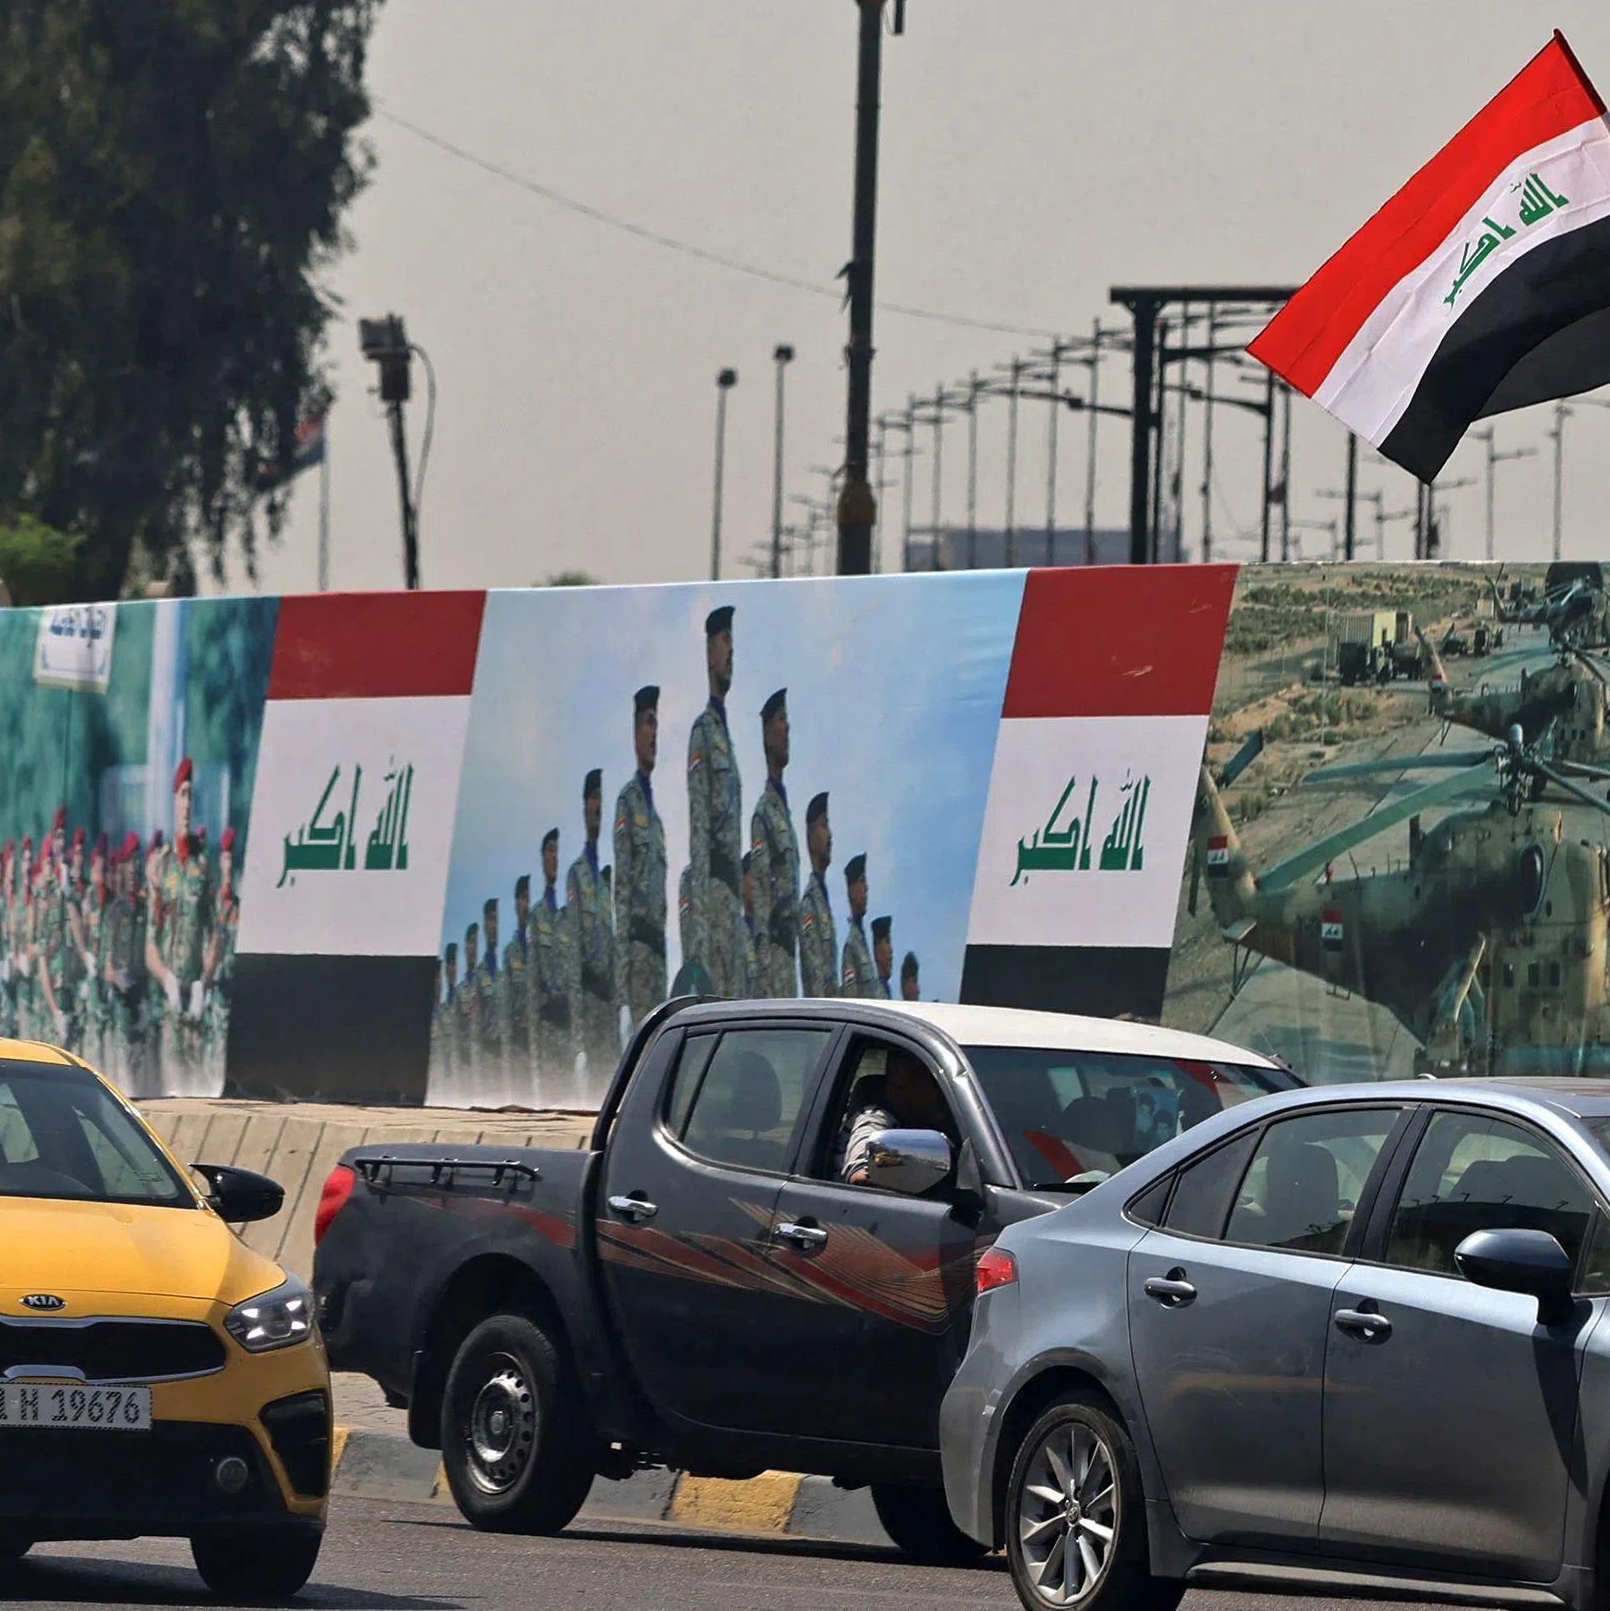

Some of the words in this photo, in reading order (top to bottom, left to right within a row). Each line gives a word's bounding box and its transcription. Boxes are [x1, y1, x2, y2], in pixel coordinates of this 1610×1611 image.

[1510, 173, 1570, 227] الله
[364, 758, 415, 871] الله
[1099, 768, 1151, 871] الله
[27, 1295, 59, 1306] KIA
[20, 1388, 40, 1422] H
[51, 1389, 141, 1425] 19676
